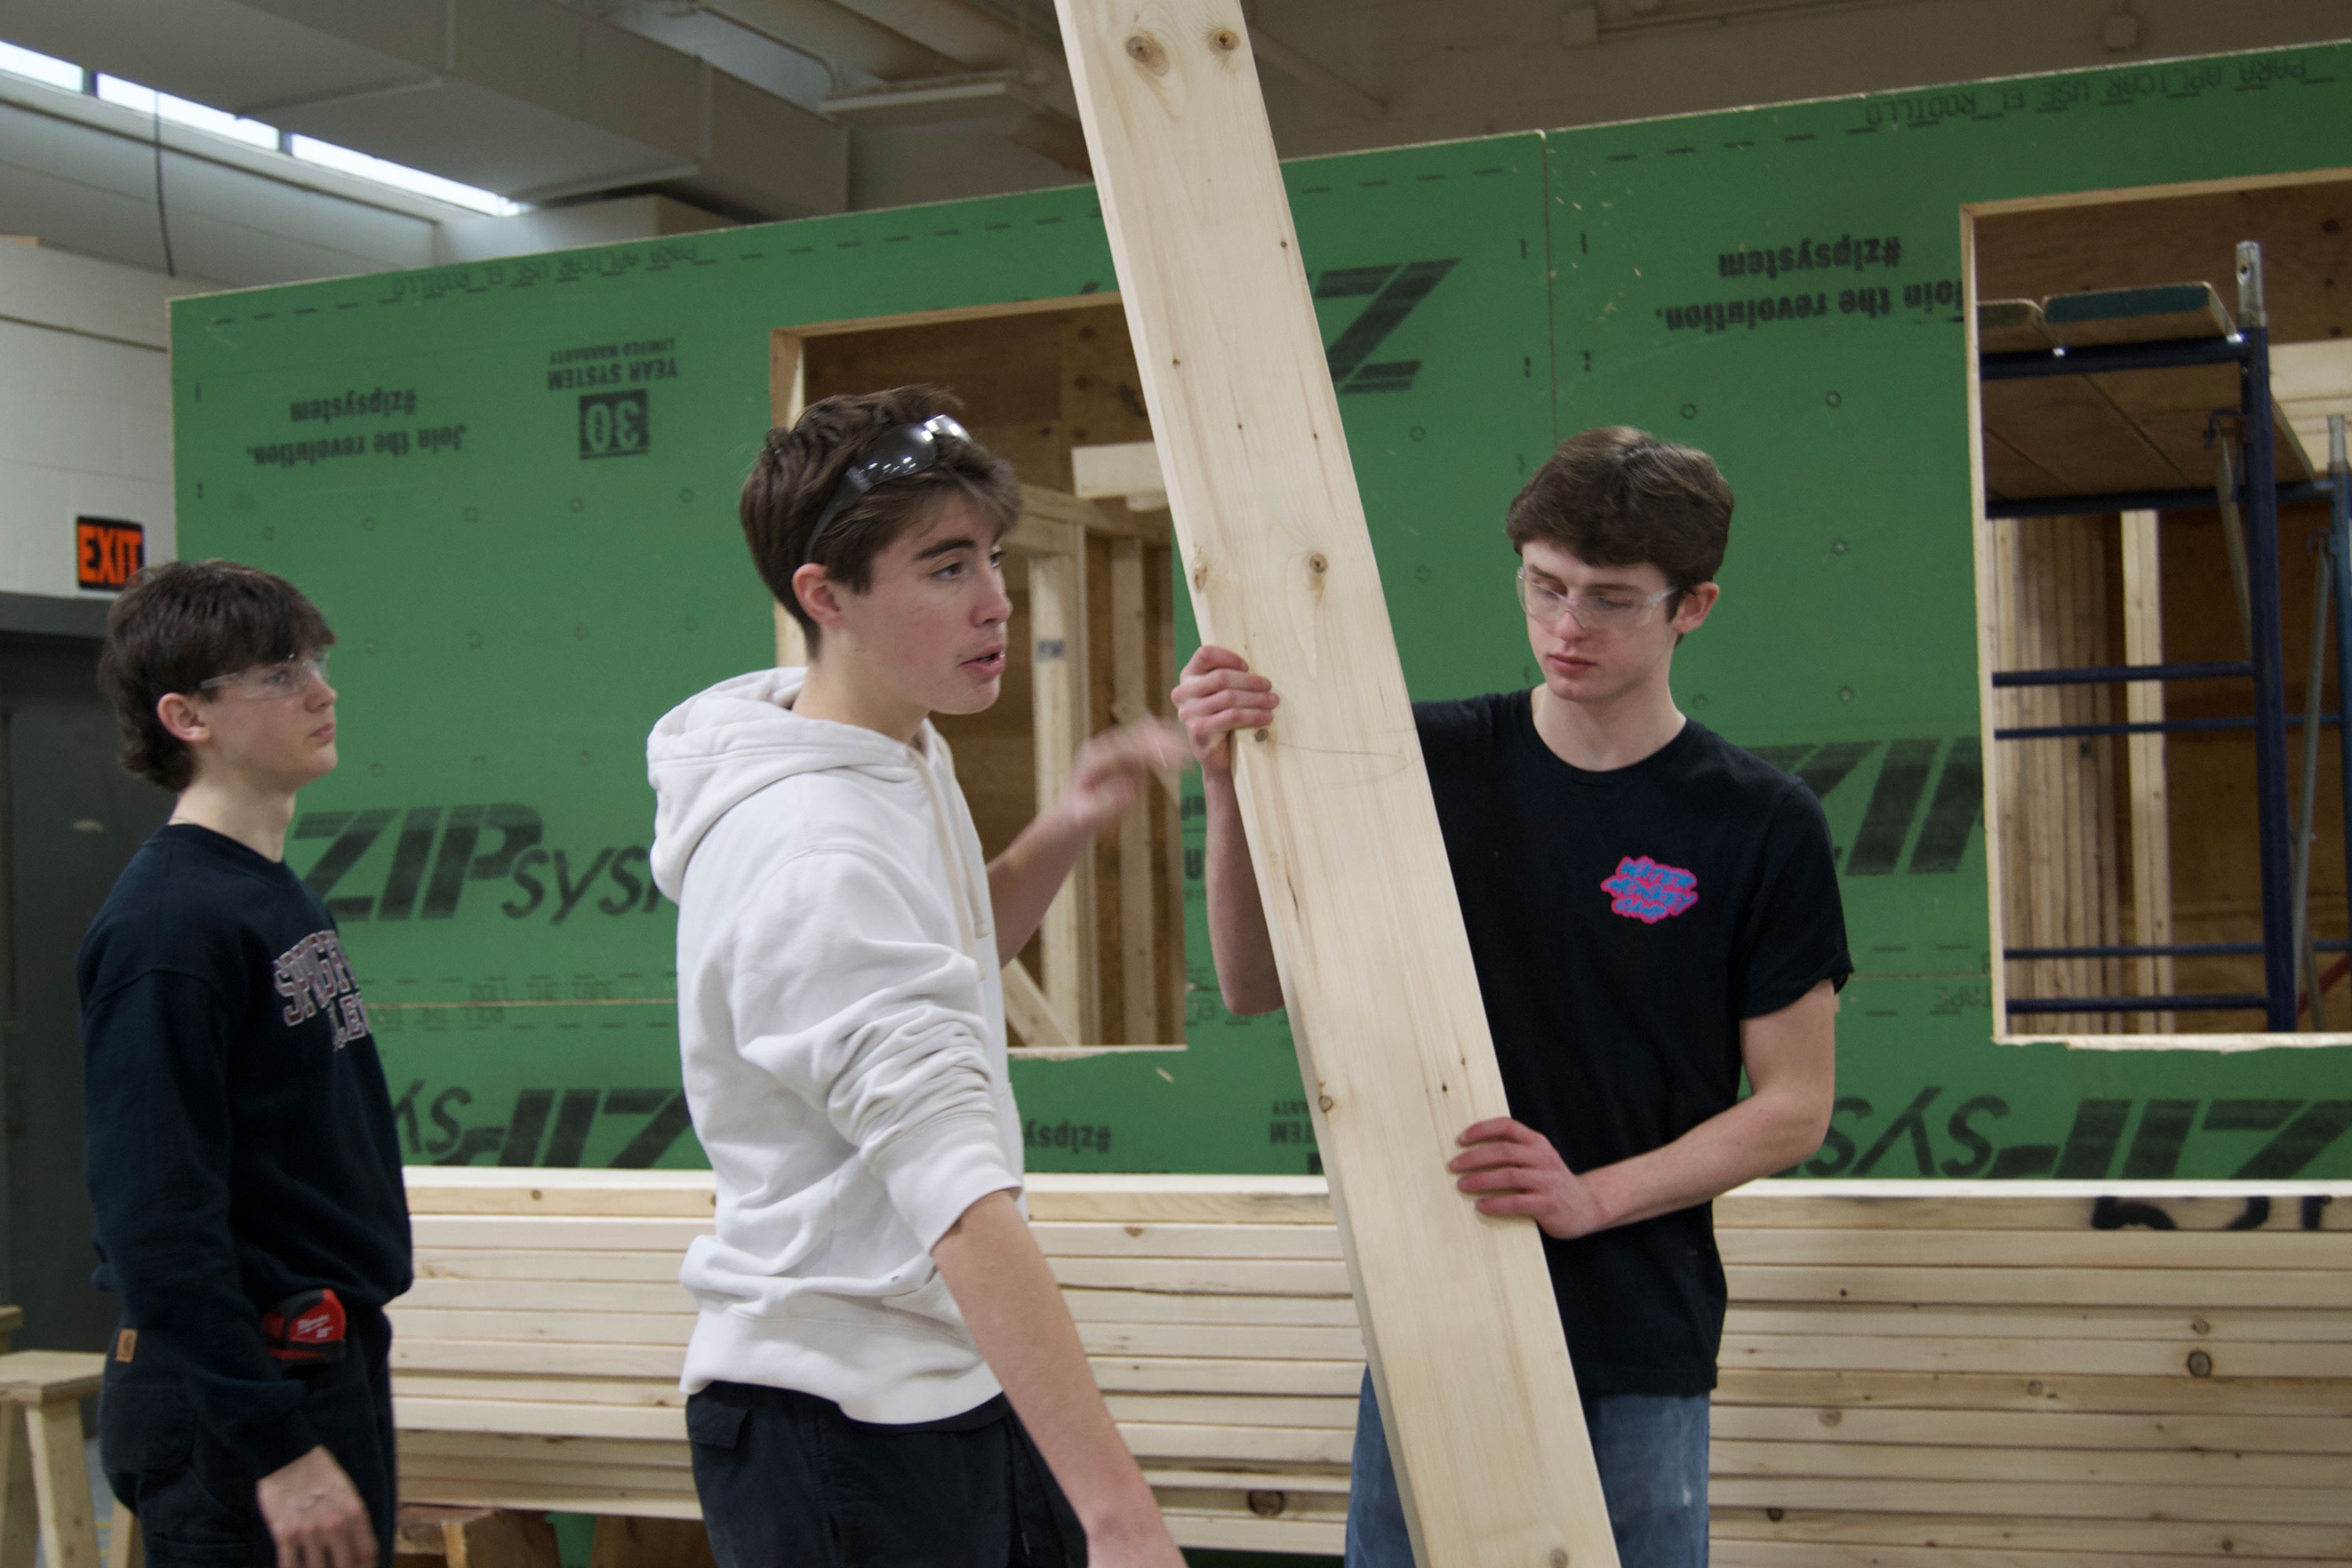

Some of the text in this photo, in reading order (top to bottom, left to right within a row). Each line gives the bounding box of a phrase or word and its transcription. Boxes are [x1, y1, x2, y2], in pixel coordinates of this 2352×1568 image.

[2107, 65, 2221, 100] APLICAR
[2238, 57, 2307, 86] PARA
[2041, 79, 2089, 105] USE
[1719, 234, 1900, 280] #zipsystem
[1655, 293, 1827, 335] revolution.
[1838, 288, 1890, 319] the
[550, 338, 675, 365] LIMITED WARRANTY
[548, 358, 677, 392] YEAR SYSTEM
[291, 387, 416, 424] #zipsystem
[586, 401, 640, 452] 30
[246, 425, 468, 469] Join the revolution.
[79, 524, 142, 584] EXIT
